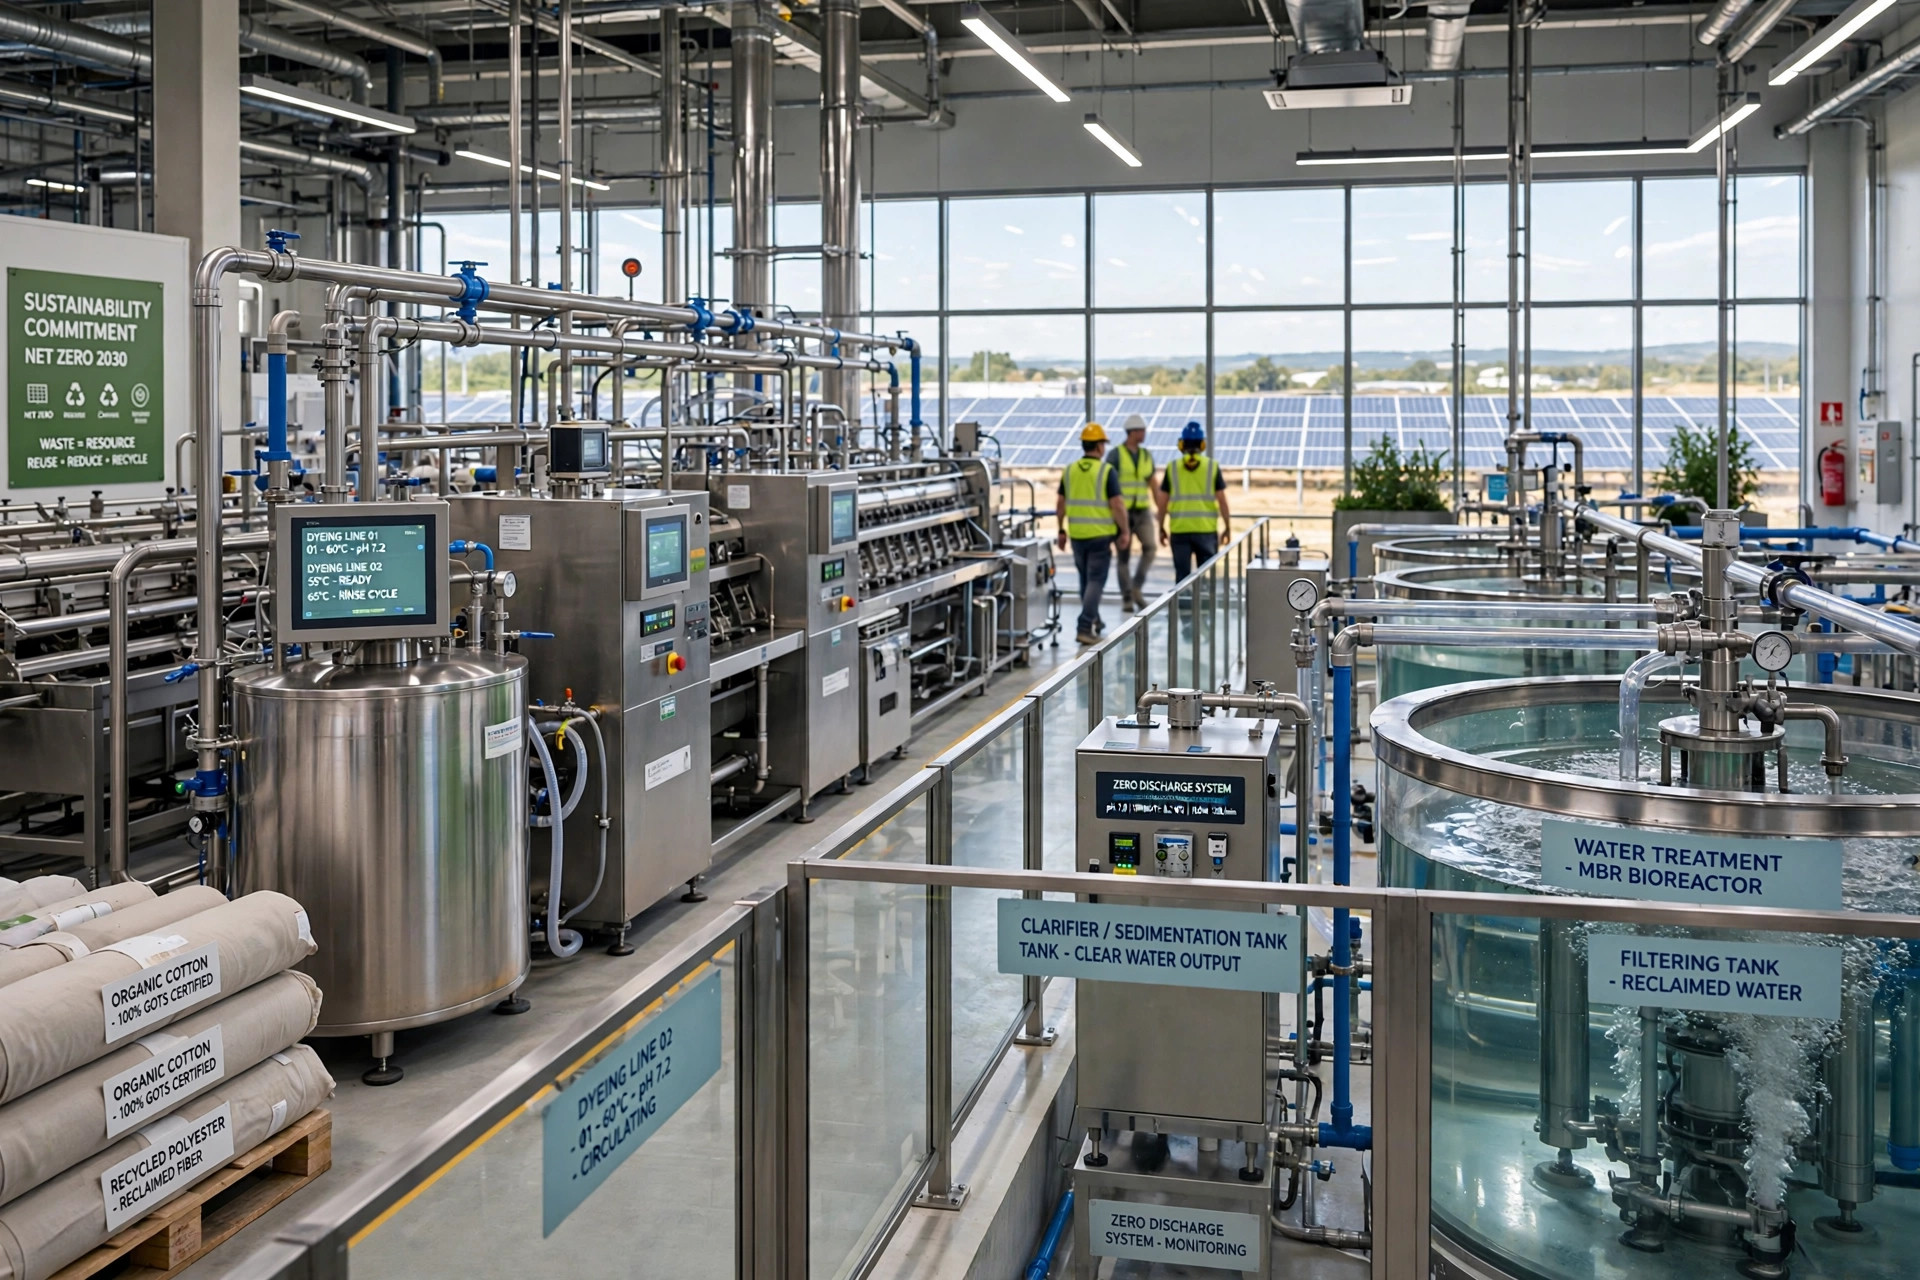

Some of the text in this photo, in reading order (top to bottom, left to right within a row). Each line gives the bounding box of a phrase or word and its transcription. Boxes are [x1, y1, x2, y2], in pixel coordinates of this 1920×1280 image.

[24, 292, 151, 319] SUSTAINABILITY
[24, 318, 138, 342] COMMITMENT
[25, 347, 128, 367] NET ZERO 2030
[39, 437, 75, 450] WASTE
[86, 436, 135, 450] RESOURCE
[27, 456, 58, 469] REUSE
[67, 455, 103, 467] REDUCE
[112, 453, 148, 465] RECYCLE
[306, 531, 378, 542] DYEING LINE 01
[306, 545, 317, 554] 01
[356, 543, 369, 555] pH
[372, 543, 386, 553] 7.2
[307, 562, 383, 573] DYEING LINE 02
[339, 574, 372, 585] READY
[339, 590, 366, 600] RINSE
[368, 588, 398, 599] CYCLE
[1113, 779, 1232, 794] ZERO DISCHARGE SYSTEM
[1574, 837, 1783, 872] WATER TREATMENT
[1579, 861, 1622, 882] MBR
[1629, 866, 1763, 895] BIOREACTOR
[1021, 917, 1099, 938] CLARIFIER
[1115, 923, 1241, 947] SEDIMENTATION
[1245, 931, 1288, 950] TANK
[1019, 941, 1059, 960] TANK
[1074, 945, 1122, 964] CLEAR
[1126, 949, 1176, 968] WATER
[1180, 952, 1241, 972] OUTPUT
[1621, 950, 1779, 976] FILTERING TANK
[111, 954, 209, 1008] ORGANIC COTTON
[1622, 974, 1731, 997] RECLAIMED
[1735, 981, 1802, 1001] WATER
[118, 1005, 142, 1027] 100%
[143, 991, 169, 1014] GOTS
[170, 972, 214, 1002] CERTIFIED
[113, 1039, 211, 1101] ORGANIC COTTON
[578, 1027, 673, 1120] DYEING LINE 02
[119, 1097, 144, 1120] 100%
[145, 1082, 170, 1105] GOTS
[172, 1057, 217, 1092] CERTIFIED
[579, 1126, 592, 1149] 01
[639, 1072, 653, 1102] pH
[656, 1056, 671, 1083] 7.2
[580, 1096, 656, 1176] CIRCULATING
[110, 1115, 225, 1195] RECYCLED POLYESTER
[120, 1165, 175, 1211] RECLAIMED
[177, 1150, 203, 1176] FIBER
[1111, 1213, 1224, 1237] ZERO DISCHARGE
[1105, 1231, 1154, 1248] SYSTEM
[1165, 1237, 1247, 1257] MONITORING
